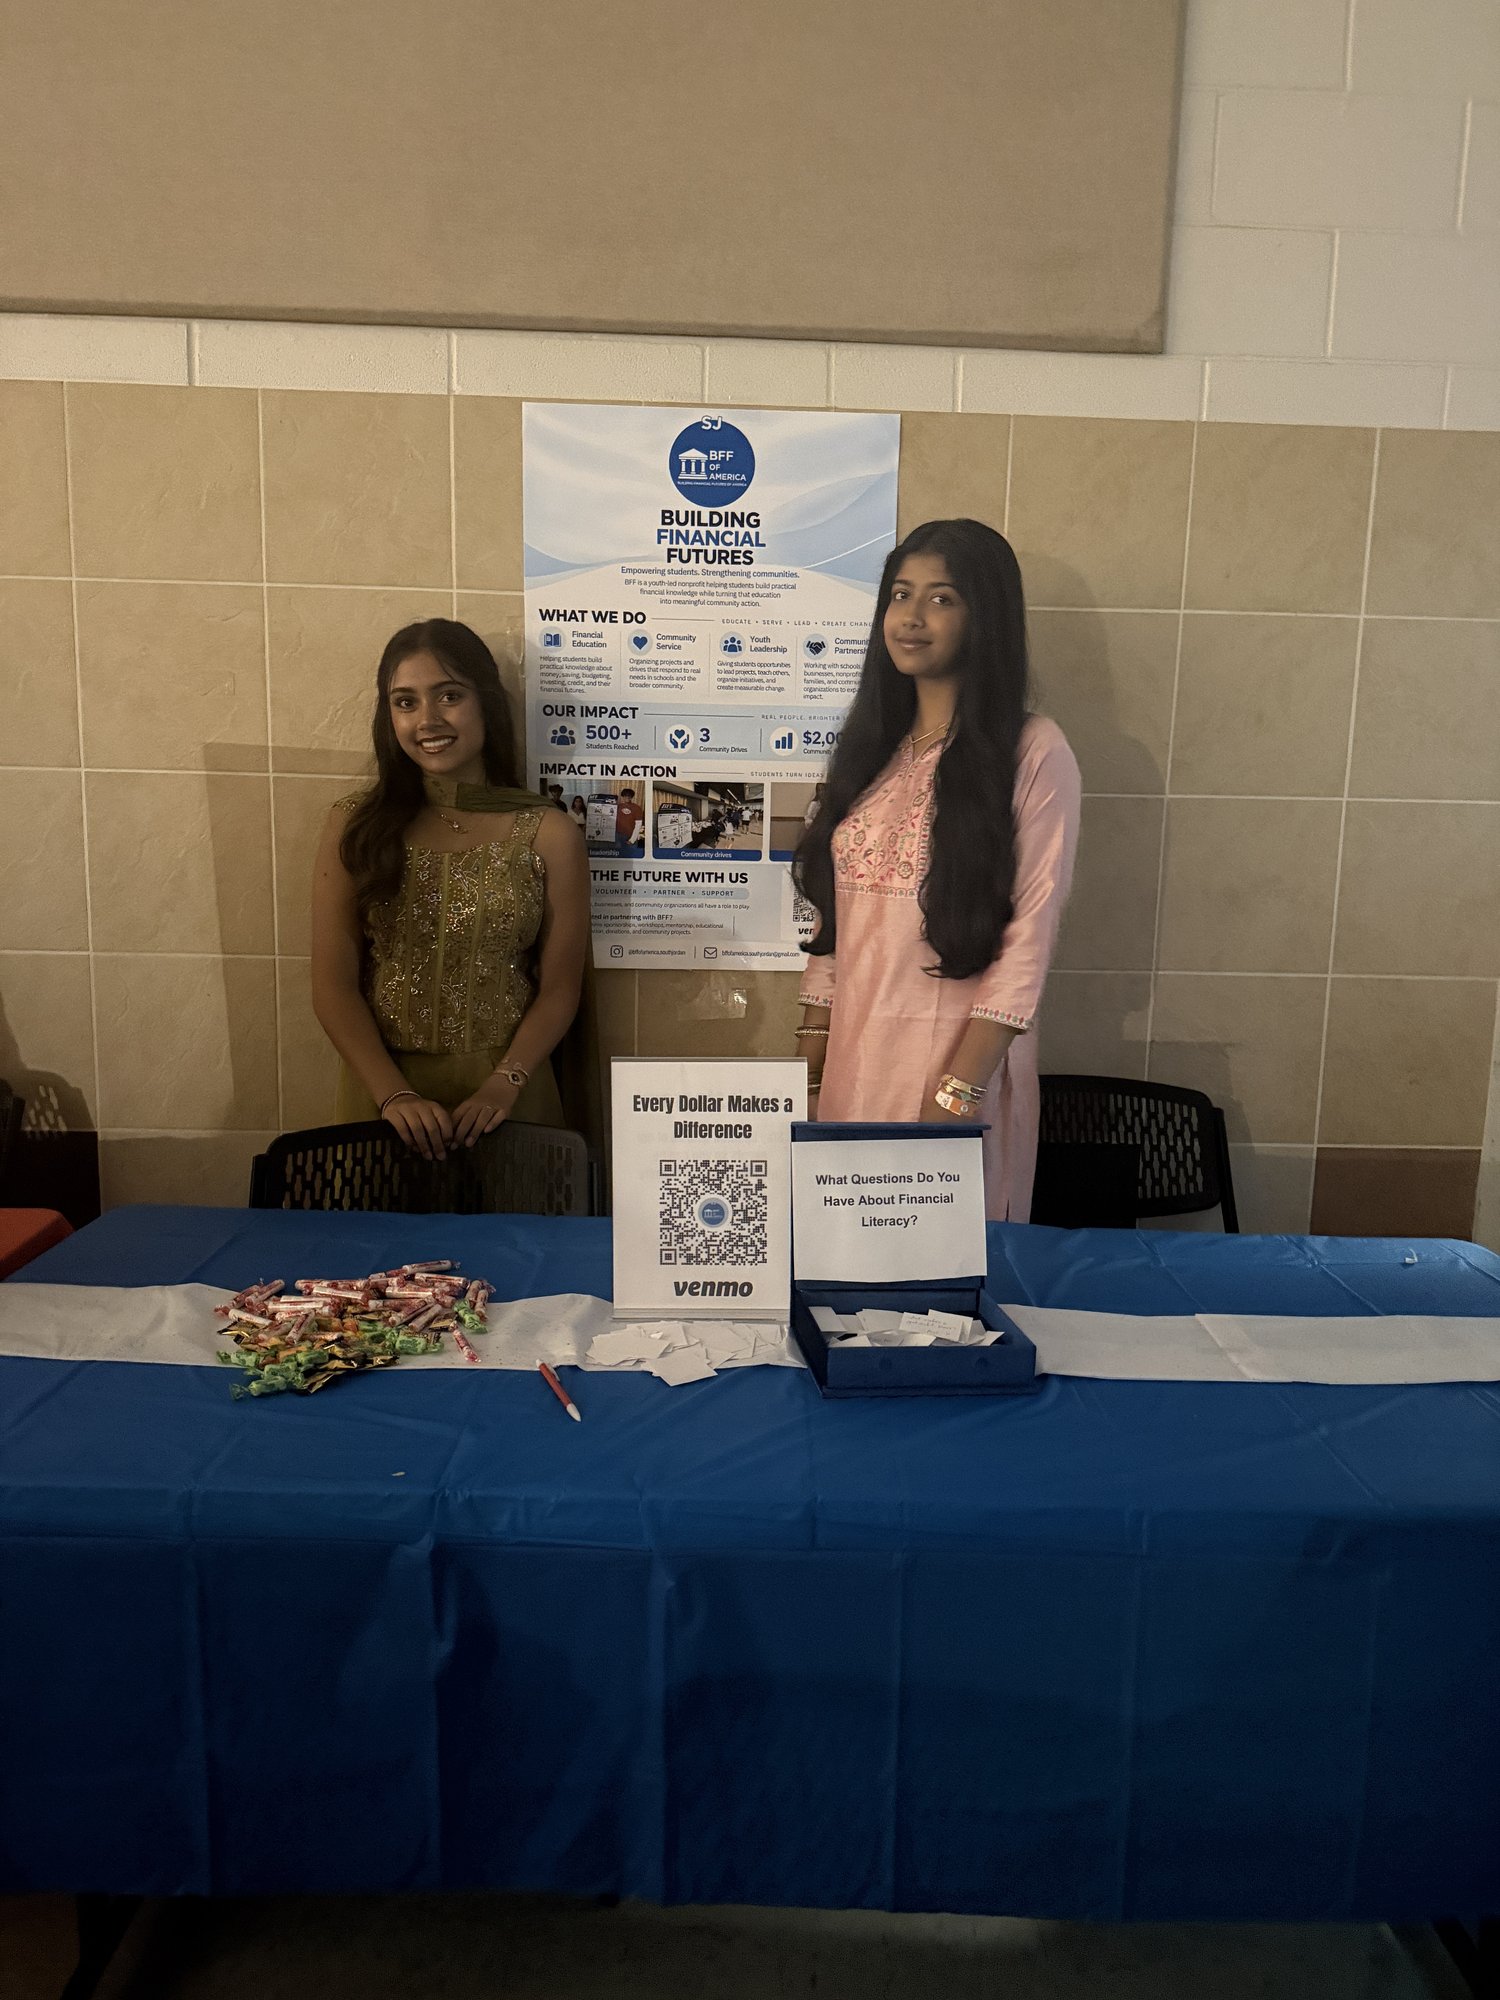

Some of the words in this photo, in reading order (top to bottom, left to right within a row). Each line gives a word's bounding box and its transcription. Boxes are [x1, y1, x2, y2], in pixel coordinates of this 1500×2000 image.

[701, 415, 722, 430] SJ
[709, 450, 734, 461] BFF
[709, 473, 746, 481] AMERICA
[661, 510, 760, 528] BUILDING
[657, 529, 766, 547] FINANCIAL
[667, 548, 753, 565] FUTURES
[621, 566, 665, 576] Empowering
[667, 568, 700, 576] students.
[702, 569, 751, 579] Strengthening
[666, 589, 698, 597] knowledge
[673, 598, 705, 606] meaningful
[706, 599, 739, 607] community
[539, 609, 588, 622] WHAT
[592, 610, 618, 623] WE
[623, 612, 646, 624] DO
[572, 631, 603, 639] Financial
[656, 634, 696, 643] Community
[572, 640, 607, 648] Education
[750, 645, 787, 654] Leadership
[629, 658, 658, 666] Organizing
[543, 705, 576, 717] OUR
[581, 706, 639, 719] IMPACT
[586, 725, 632, 740] 500+
[700, 728, 710, 743] 3
[540, 763, 596, 775] IMPACT
[600, 765, 616, 776] IN
[620, 765, 676, 777] ACTION
[681, 851, 713, 859] Community
[591, 870, 619, 881] THE
[624, 871, 681, 882] FUTURE
[685, 872, 724, 883] WITH
[729, 873, 748, 883] US
[633, 1095, 674, 1115] Every
[679, 1095, 723, 1113] Dollar
[728, 1095, 778, 1113] Makes
[783, 1098, 793, 1113] a
[673, 1121, 752, 1139] Difference
[815, 1173, 848, 1186] What
[851, 1172, 914, 1186] Questions
[917, 1172, 934, 1184] Do
[937, 1171, 960, 1183] You
[823, 1194, 855, 1207] Have
[858, 1193, 895, 1206] About
[899, 1192, 954, 1205] Financial
[861, 1215, 918, 1229] Literacy?
[673, 1280, 754, 1297] venmo
